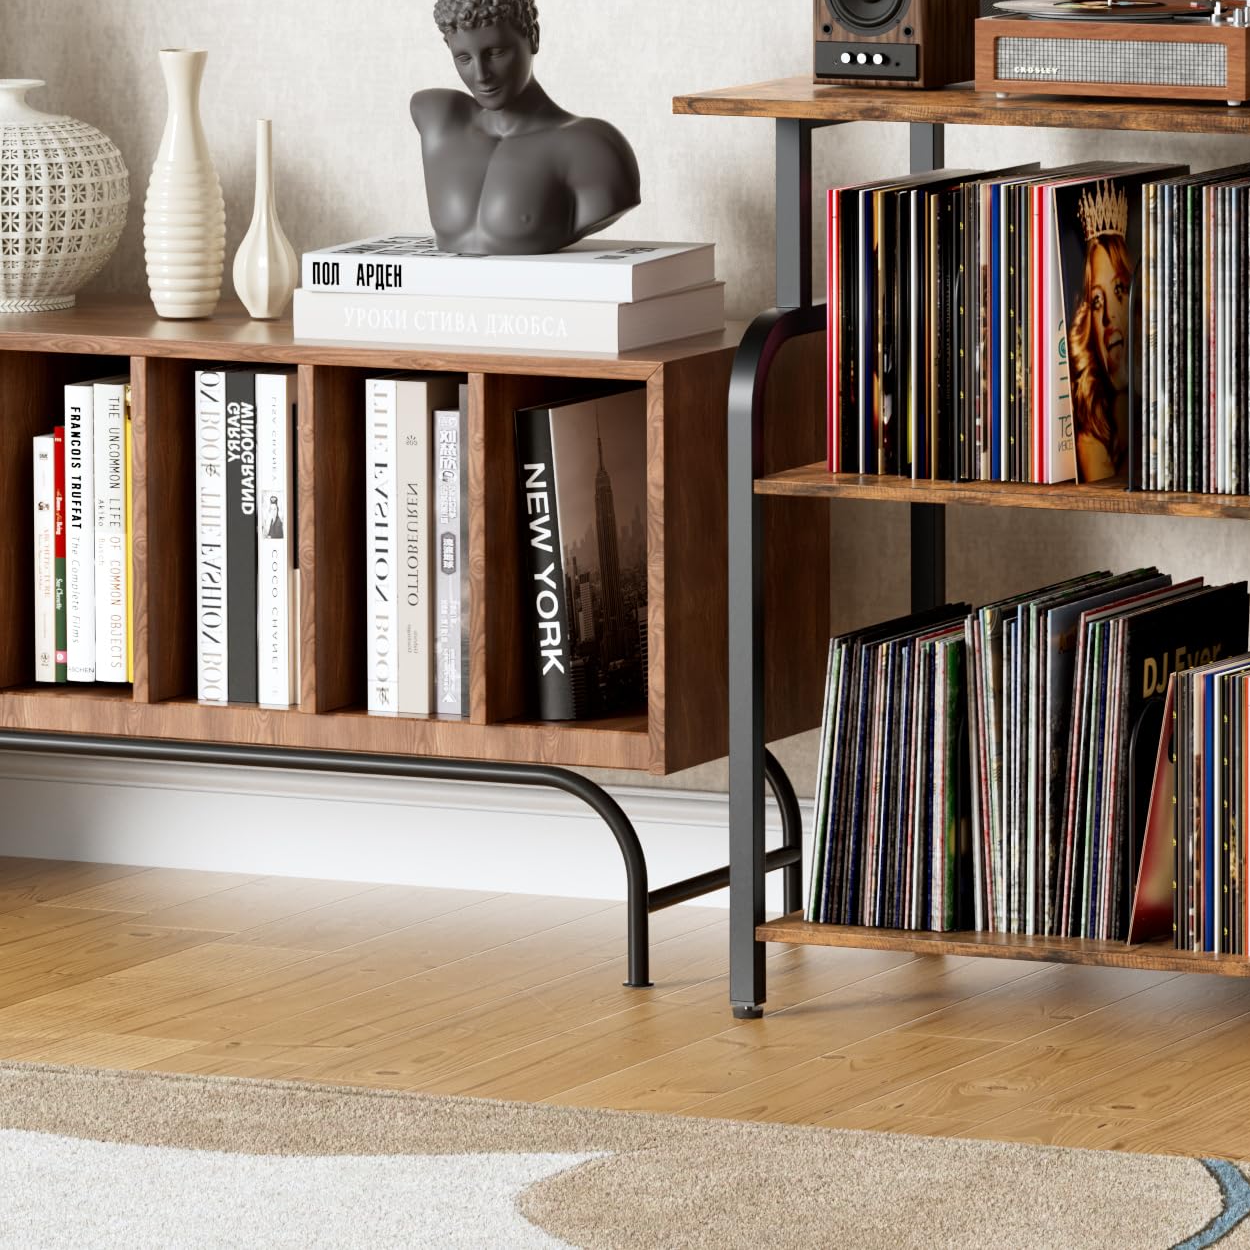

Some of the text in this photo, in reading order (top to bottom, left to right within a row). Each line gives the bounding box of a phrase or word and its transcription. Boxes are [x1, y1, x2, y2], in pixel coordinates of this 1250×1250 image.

[312, 261, 402, 291] ПОЛ АРДЕН
[343, 306, 569, 339] УРОКИ СТИВА ДЖОБСА
[70, 406, 82, 644] FRANCOIS TRUFFAT The Complete Films
[98, 499, 106, 527] Akiko
[108, 397, 122, 669] THE UNCOMMON LIFE OF COMMON OBJECTS
[523, 462, 565, 677] NEW YORK
[1143, 652, 1169, 699] DJ
